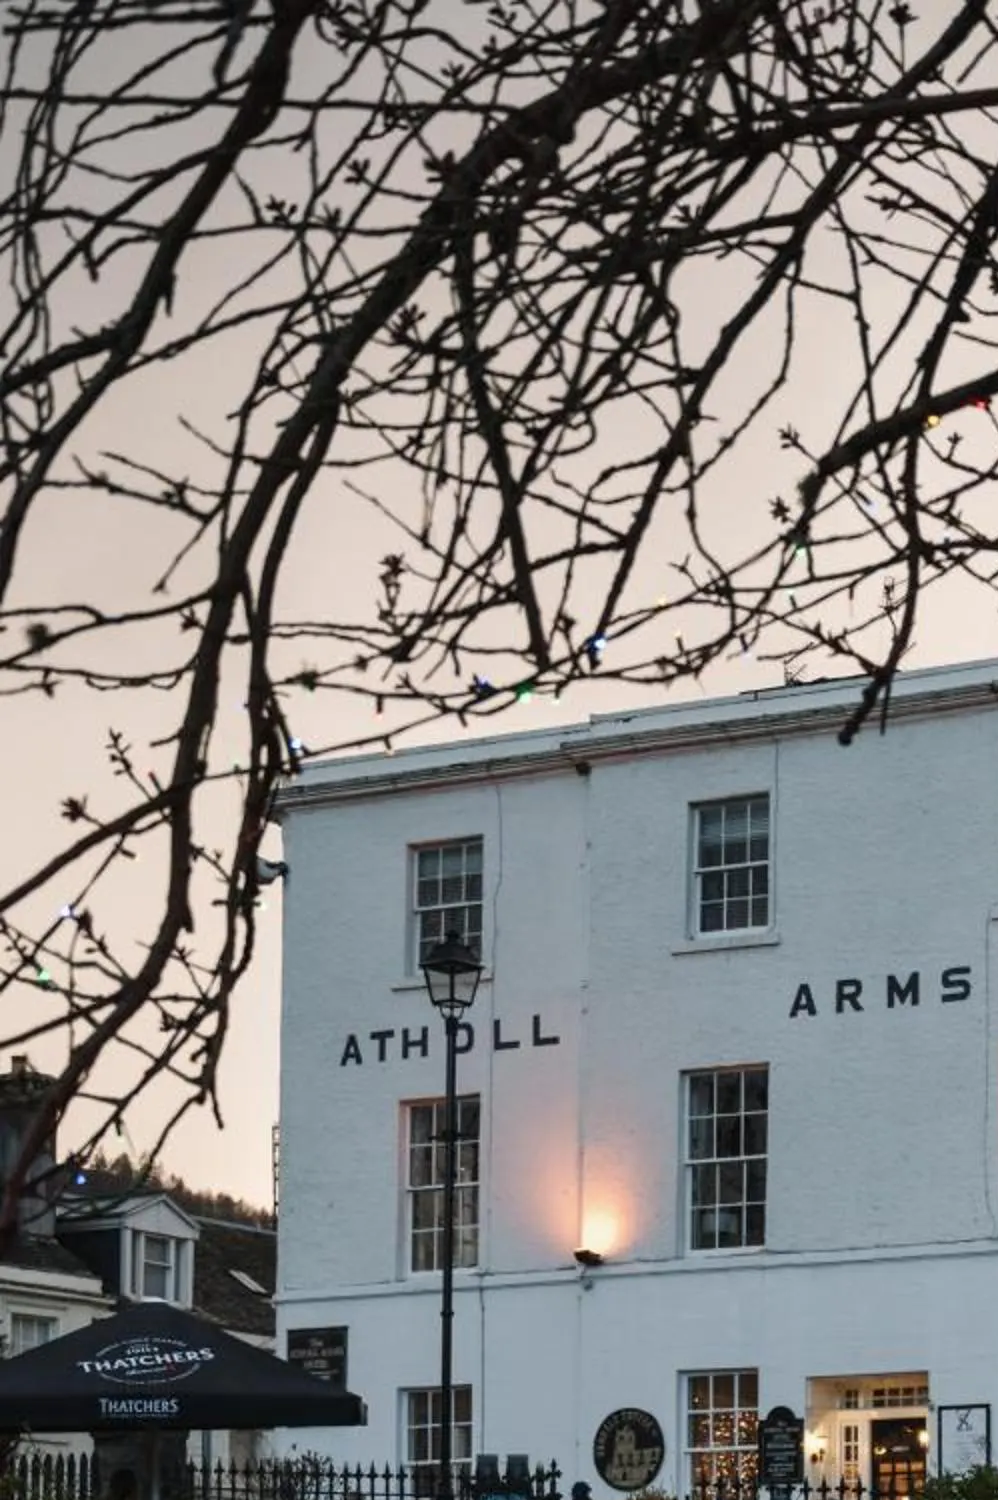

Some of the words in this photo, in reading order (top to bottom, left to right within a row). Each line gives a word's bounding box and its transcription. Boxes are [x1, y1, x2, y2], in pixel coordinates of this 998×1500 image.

[340, 1014, 560, 1067] ATHOLL
[789, 966, 972, 1018] ARMS
[78, 1347, 214, 1373] THATCHERS
[99, 1398, 179, 1413] THATCHERS
